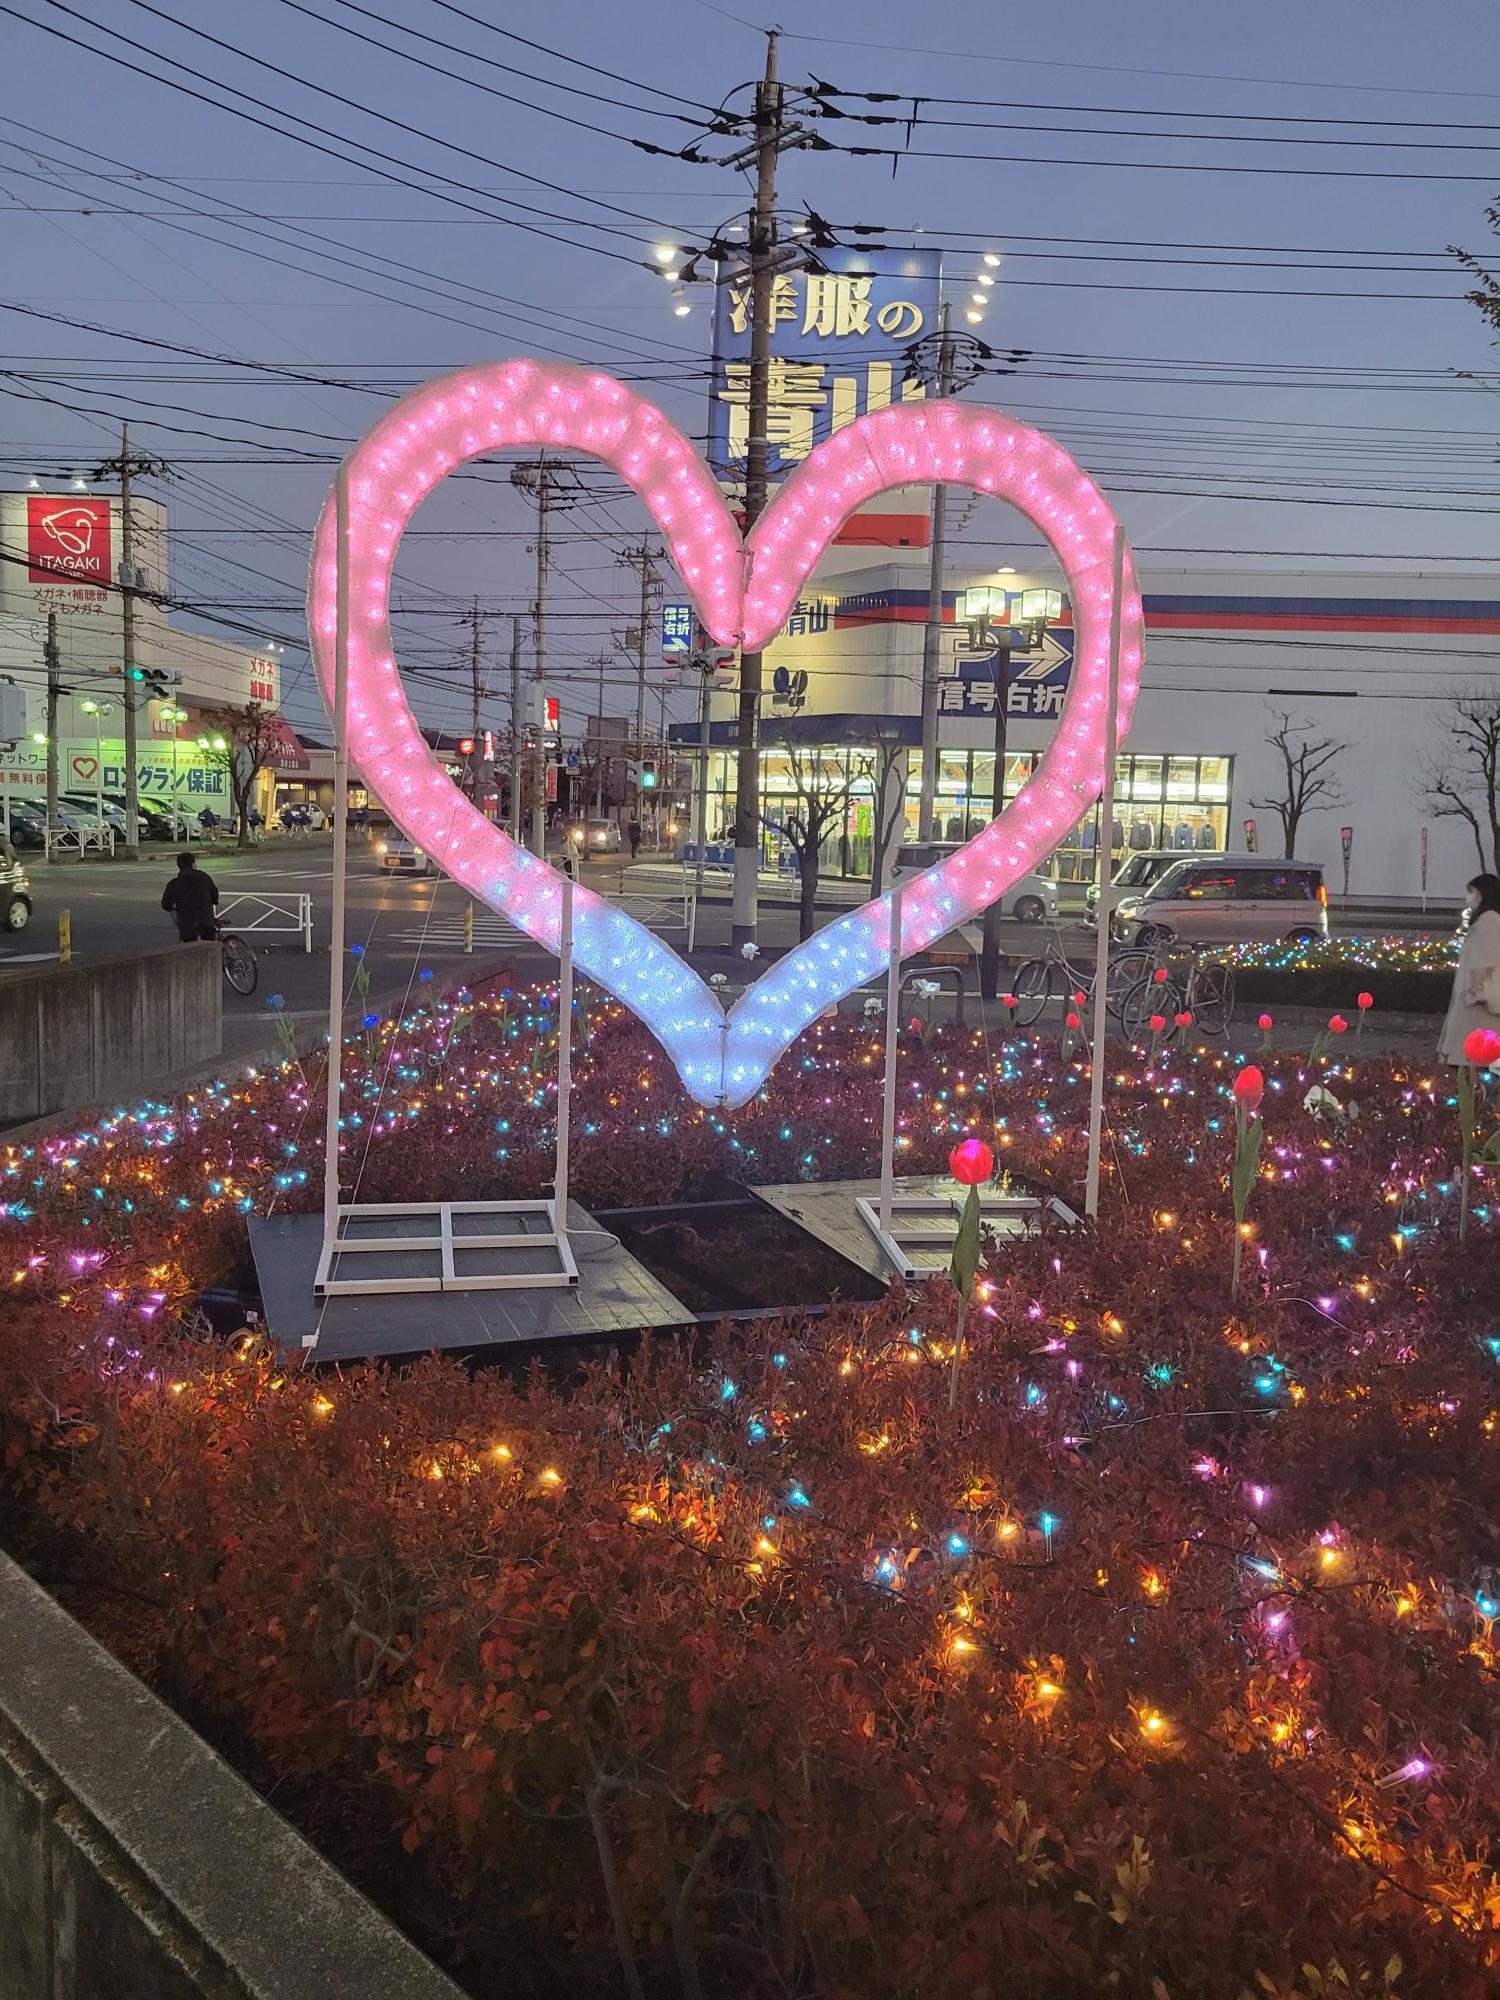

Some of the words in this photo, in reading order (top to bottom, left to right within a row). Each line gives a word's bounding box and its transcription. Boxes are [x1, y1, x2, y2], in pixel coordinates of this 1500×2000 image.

[729, 274, 923, 338] 洋服の
[38, 602, 103, 615] こどもメガネ
[937, 681, 1065, 714] 信号右折
